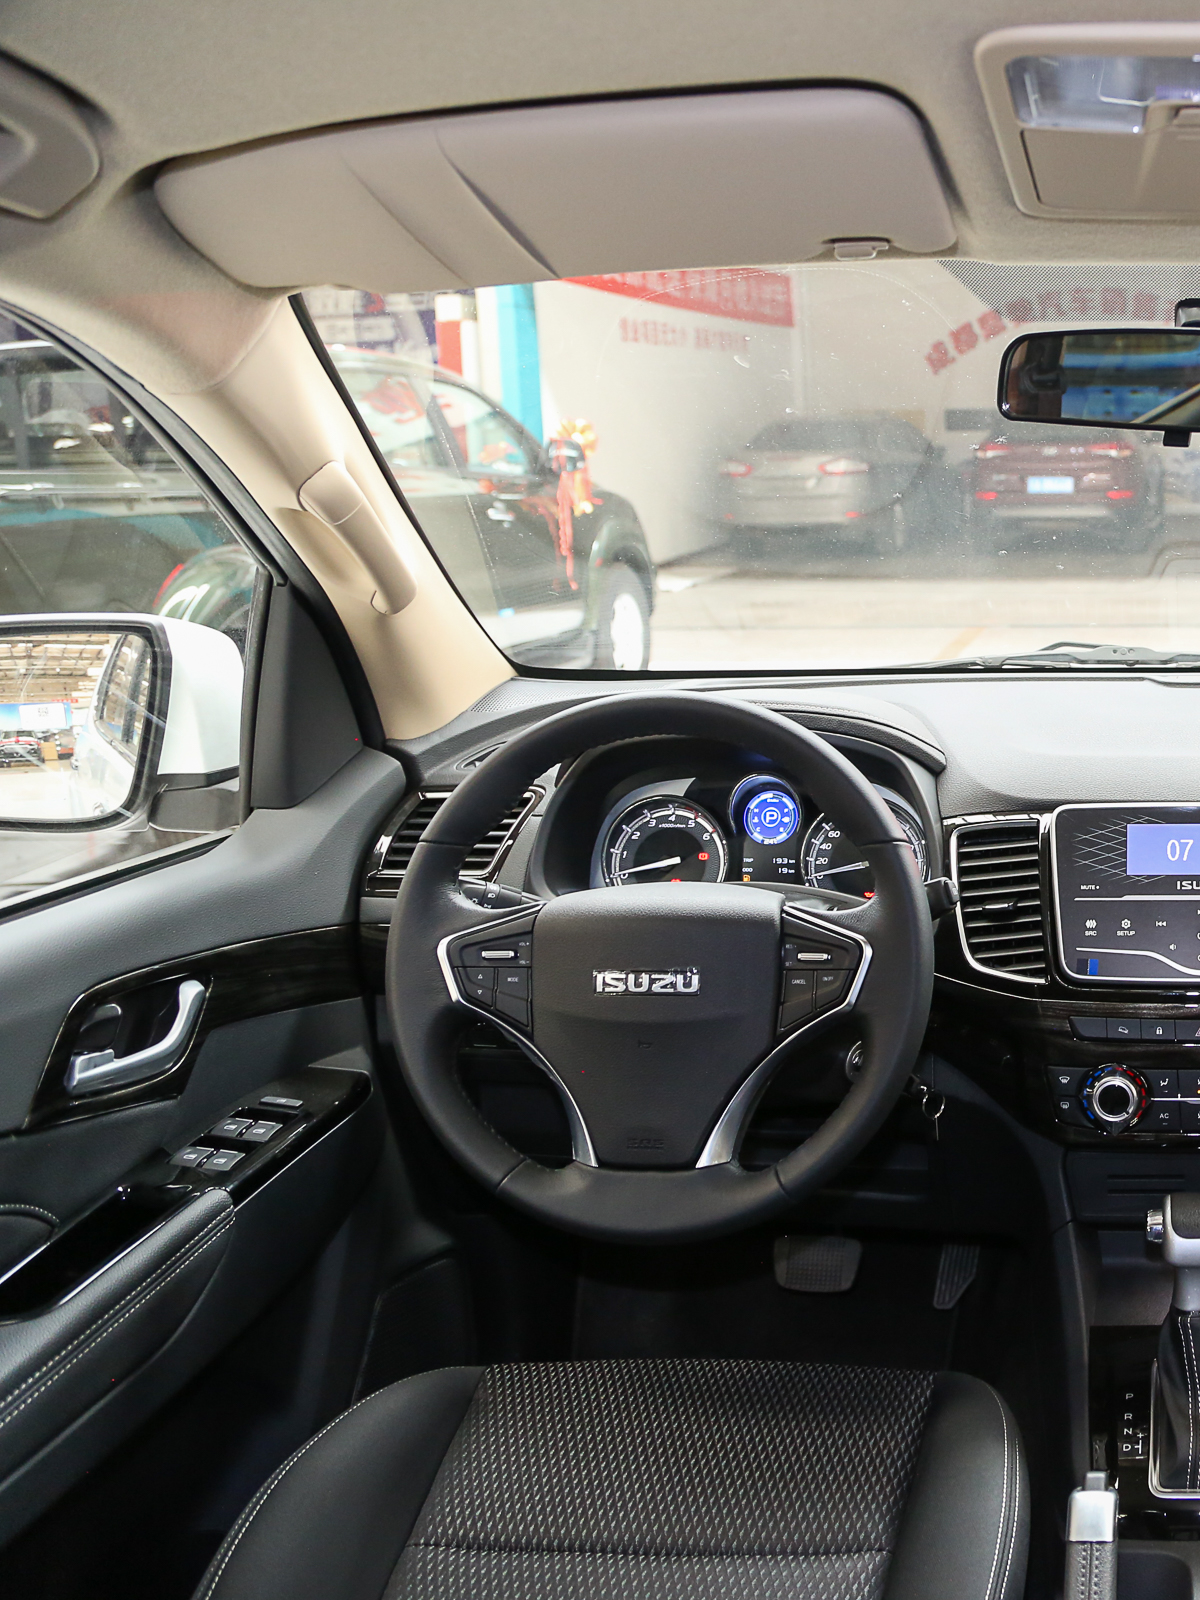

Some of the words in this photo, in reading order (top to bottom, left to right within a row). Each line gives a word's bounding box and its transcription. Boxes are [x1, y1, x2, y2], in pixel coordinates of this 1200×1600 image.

[668, 814, 676, 822] 4
[766, 811, 778, 823] P
[648, 819, 657, 827] 3
[687, 819, 696, 827] 5
[631, 832, 641, 840] 2
[702, 832, 711, 840] 6
[827, 830, 841, 838] 60
[1166, 839, 1194, 861] 07
[622, 850, 628, 859] 1
[596, 972, 699, 993] ISUZU
[1123, 1427, 1133, 1435] N
[1122, 1444, 1132, 1452] D
